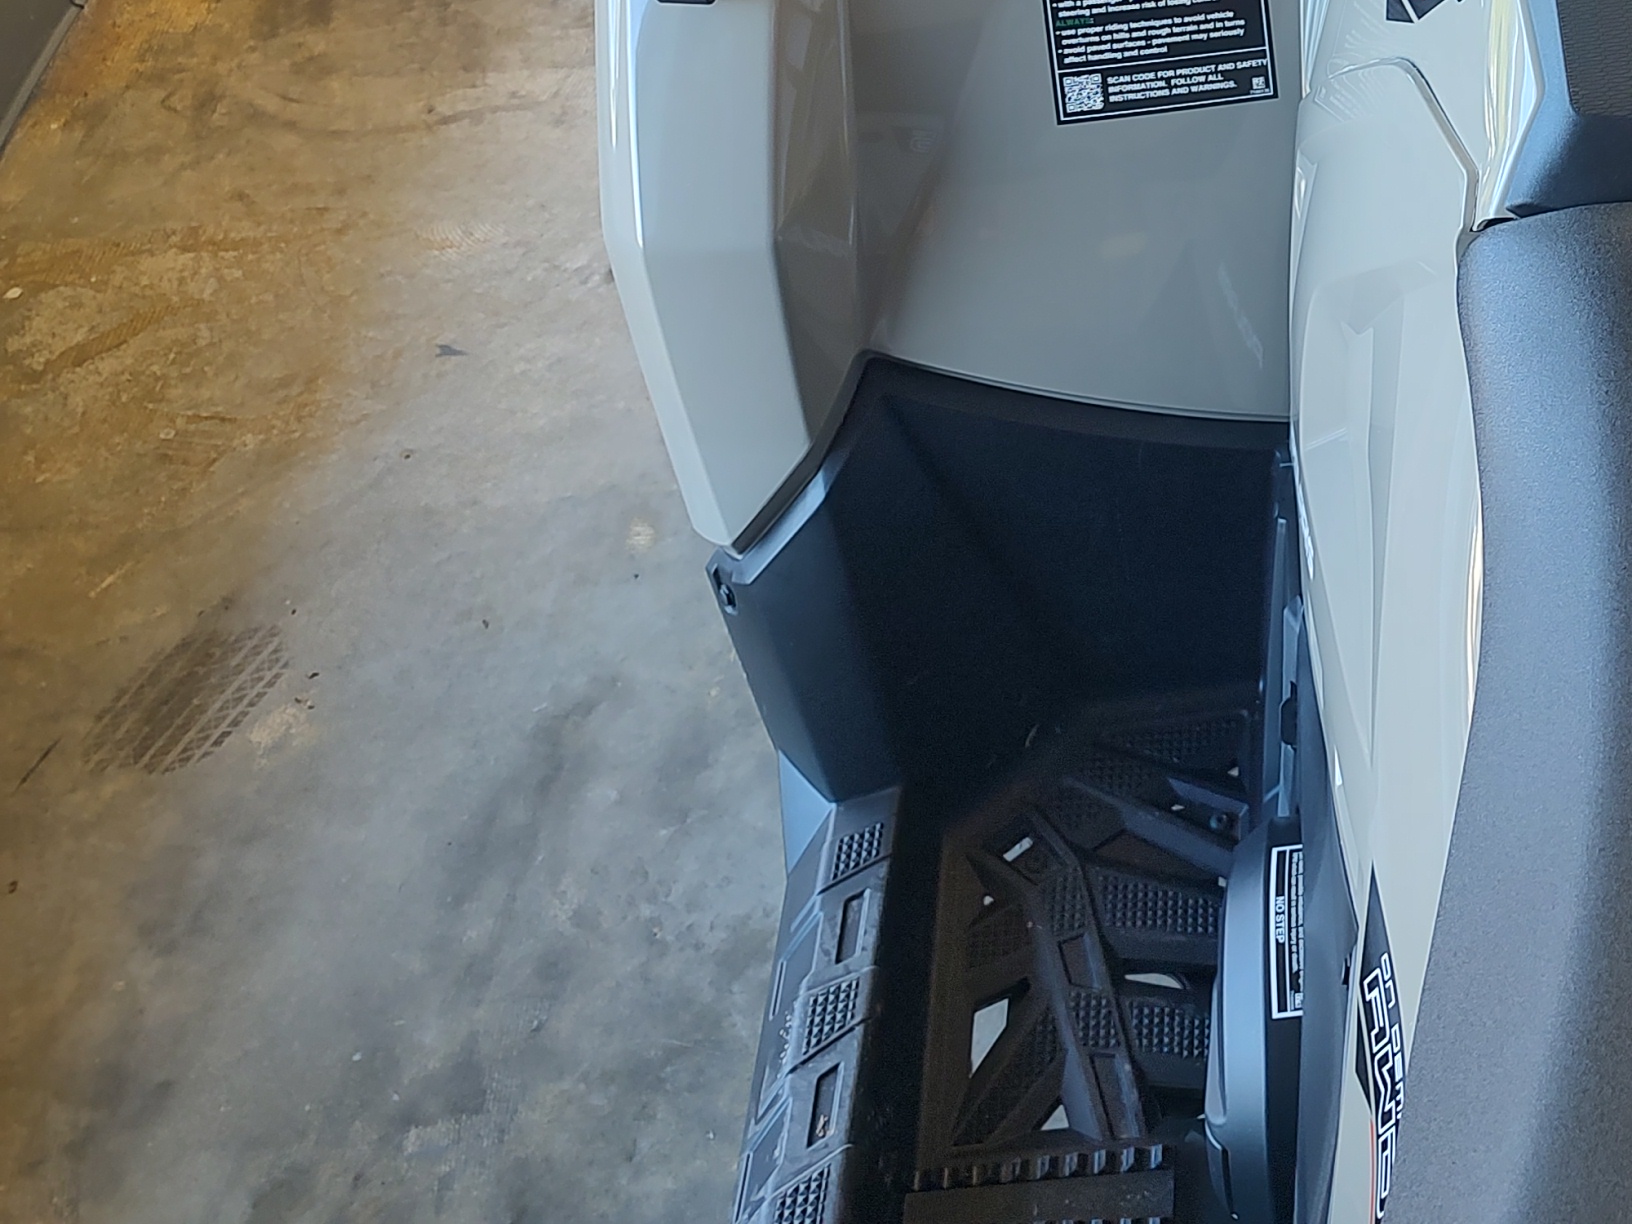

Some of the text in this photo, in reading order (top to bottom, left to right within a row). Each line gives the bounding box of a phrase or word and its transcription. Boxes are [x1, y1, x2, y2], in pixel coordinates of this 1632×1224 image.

[1107, 58, 1267, 84] SCAN CODE FOR PRODUCT AND SAFETY
[1108, 73, 1224, 93] INFORMATION. FOLLOW ALL
[1109, 89, 1170, 102] INSTRUCTIONS
[1171, 87, 1189, 95] AND
[1190, 80, 1237, 92] WARNINGS.
[1275, 896, 1285, 943] NO STEP
